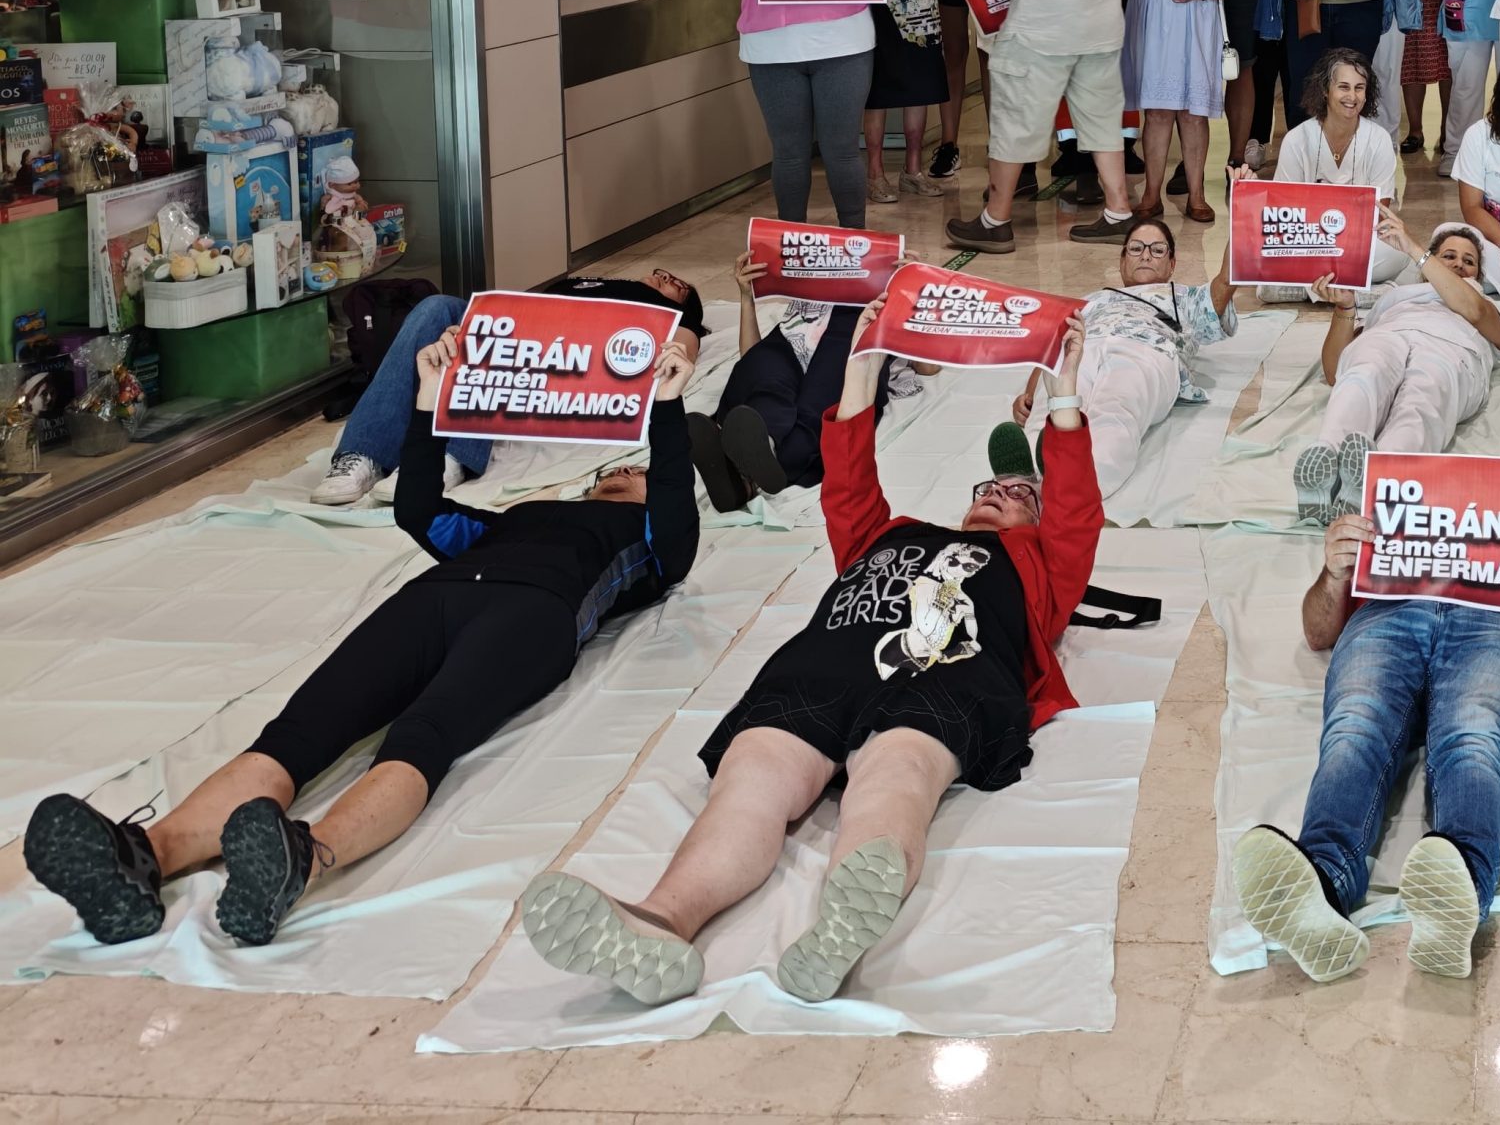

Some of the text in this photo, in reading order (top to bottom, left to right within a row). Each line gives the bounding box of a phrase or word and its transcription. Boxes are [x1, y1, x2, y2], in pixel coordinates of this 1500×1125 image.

[1264, 206, 1306, 222] NON
[1264, 223, 1320, 233] ao PECHE
[783, 232, 830, 246] NON
[1266, 234, 1336, 244] de CAMAS
[783, 246, 844, 256] ao PECHE
[785, 257, 861, 267] de CAMAS
[921, 284, 987, 300] NON
[917, 299, 1002, 313] ao PECHE
[467, 314, 515, 336] no
[915, 312, 1022, 325] de CAMAS
[465, 337, 592, 371] VERÁN
[456, 365, 548, 389] tamén
[449, 386, 640, 416] ENFERMAMOS
[1376, 478, 1423, 502] no
[1374, 536, 1466, 559] tamén
[840, 546, 926, 582] GOD
[865, 563, 920, 581] SAVE
[832, 577, 913, 613] BAD
[826, 599, 905, 630] GIRLS
